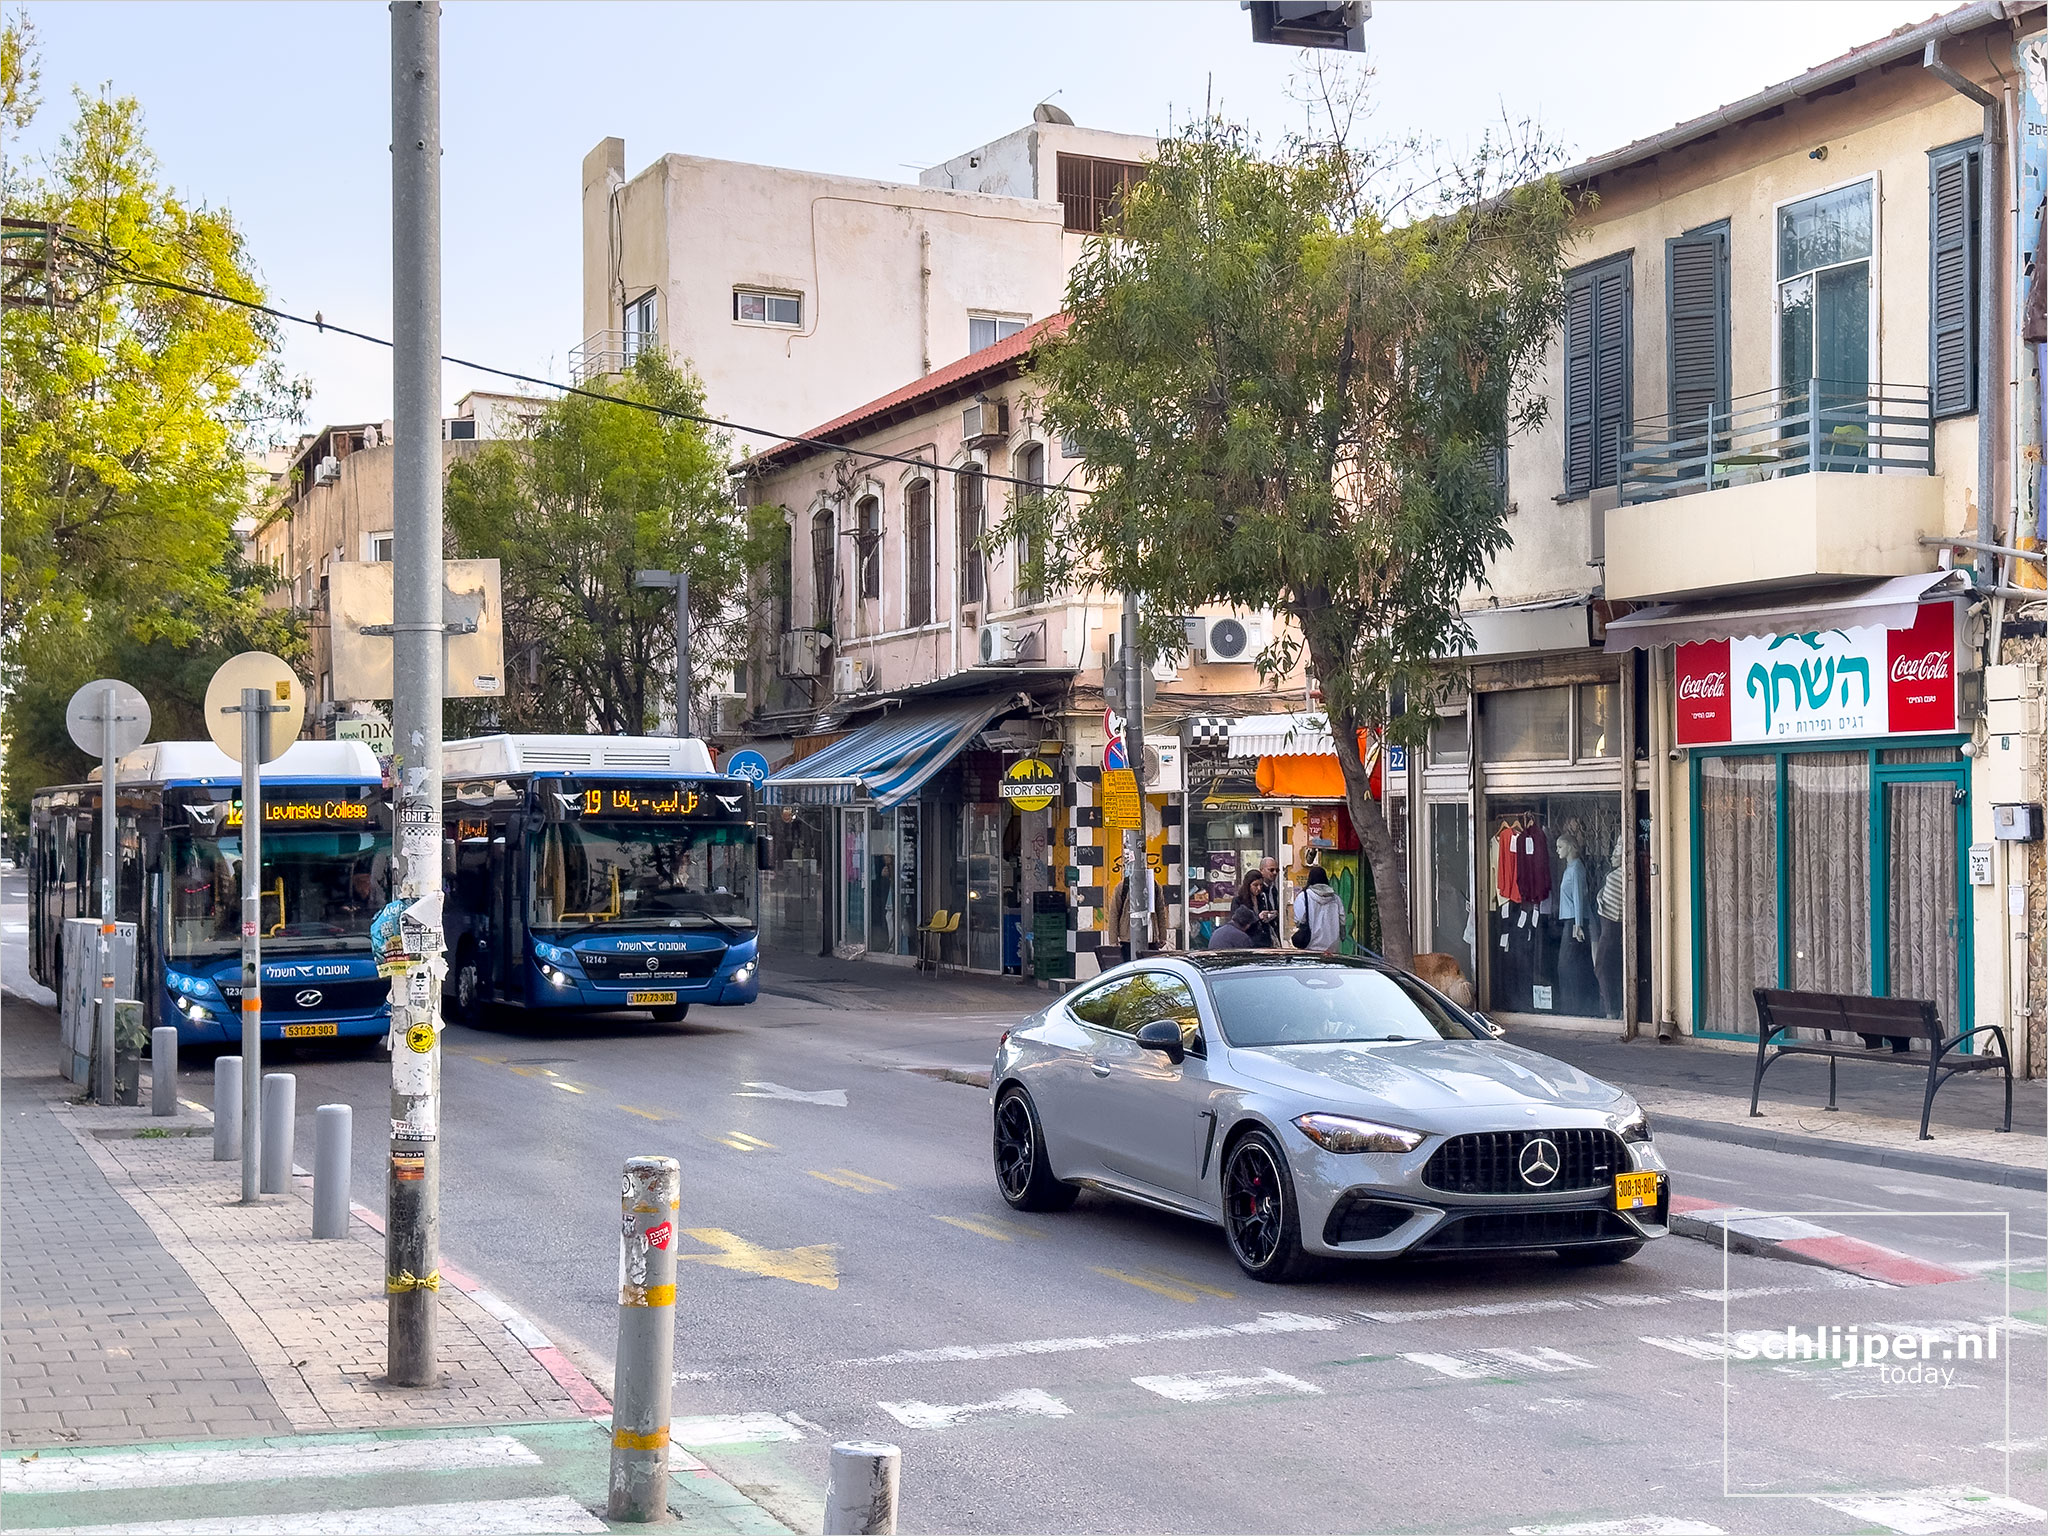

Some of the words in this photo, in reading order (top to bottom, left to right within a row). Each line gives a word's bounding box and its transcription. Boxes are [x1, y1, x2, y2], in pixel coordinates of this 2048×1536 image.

[1746, 655, 1870, 735] השחף
[1778, 722, 1790, 735] ים
[1796, 719, 1832, 733] ופירות
[1839, 715, 1864, 729] דגים
[1391, 751, 1404, 768] 22
[1004, 785, 1033, 797] STORY
[1034, 784, 1060, 796] SHOP
[584, 789, 601, 814] 19
[265, 802, 321, 820] Levinsky
[324, 800, 368, 819] College
[616, 940, 642, 952] חשמלי
[658, 941, 687, 951] אוטובוס
[266, 966, 296, 979] חשמלי
[316, 964, 350, 976] אוטובוס
[649, 1226, 670, 1240] אהבת
